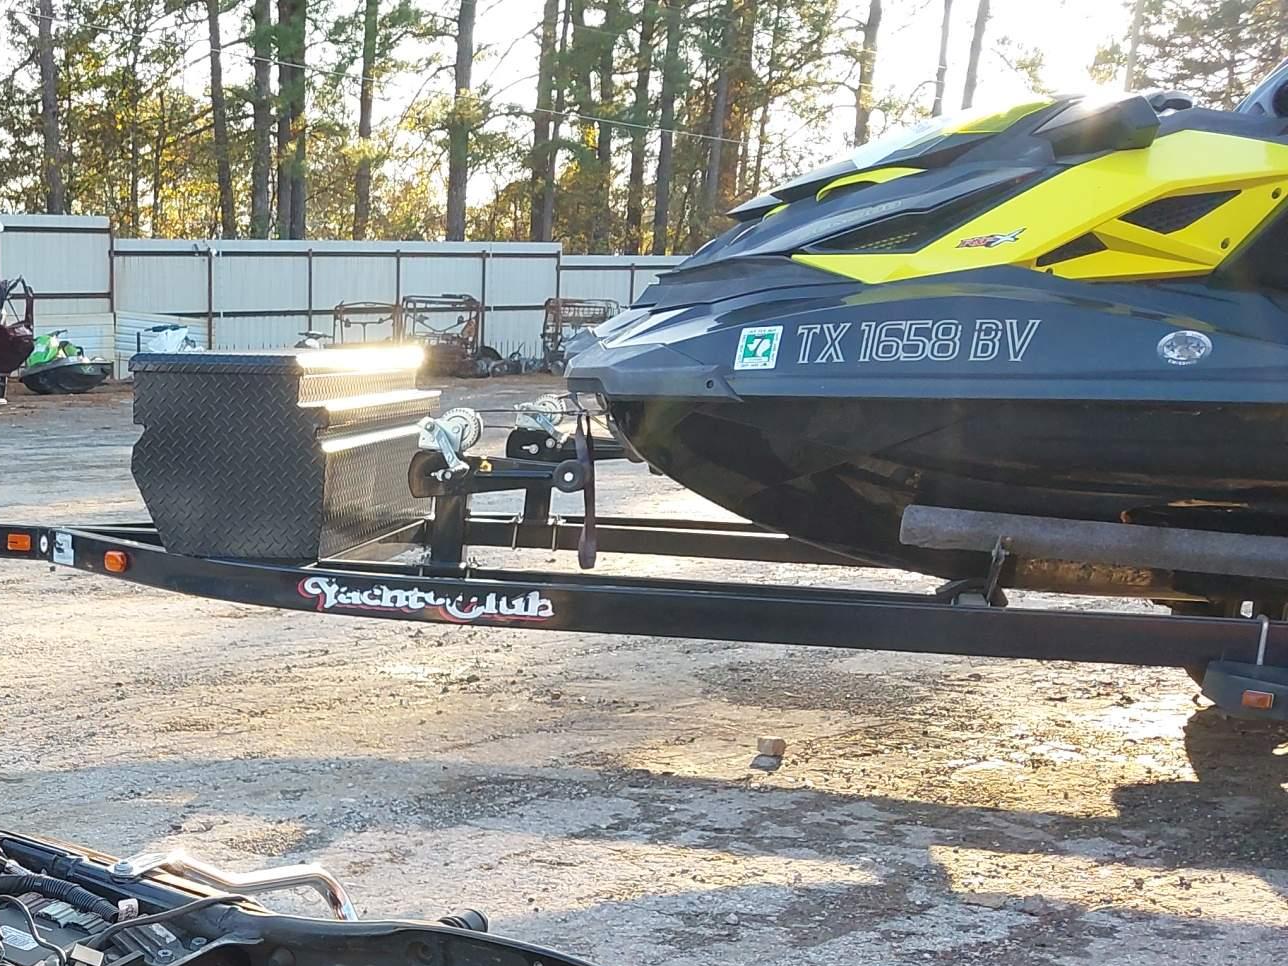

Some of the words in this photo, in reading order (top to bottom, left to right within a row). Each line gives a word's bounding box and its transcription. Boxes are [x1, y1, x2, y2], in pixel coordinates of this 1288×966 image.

[797, 323, 852, 364] TX
[858, 320, 962, 362] 1658
[968, 319, 1041, 362] BV
